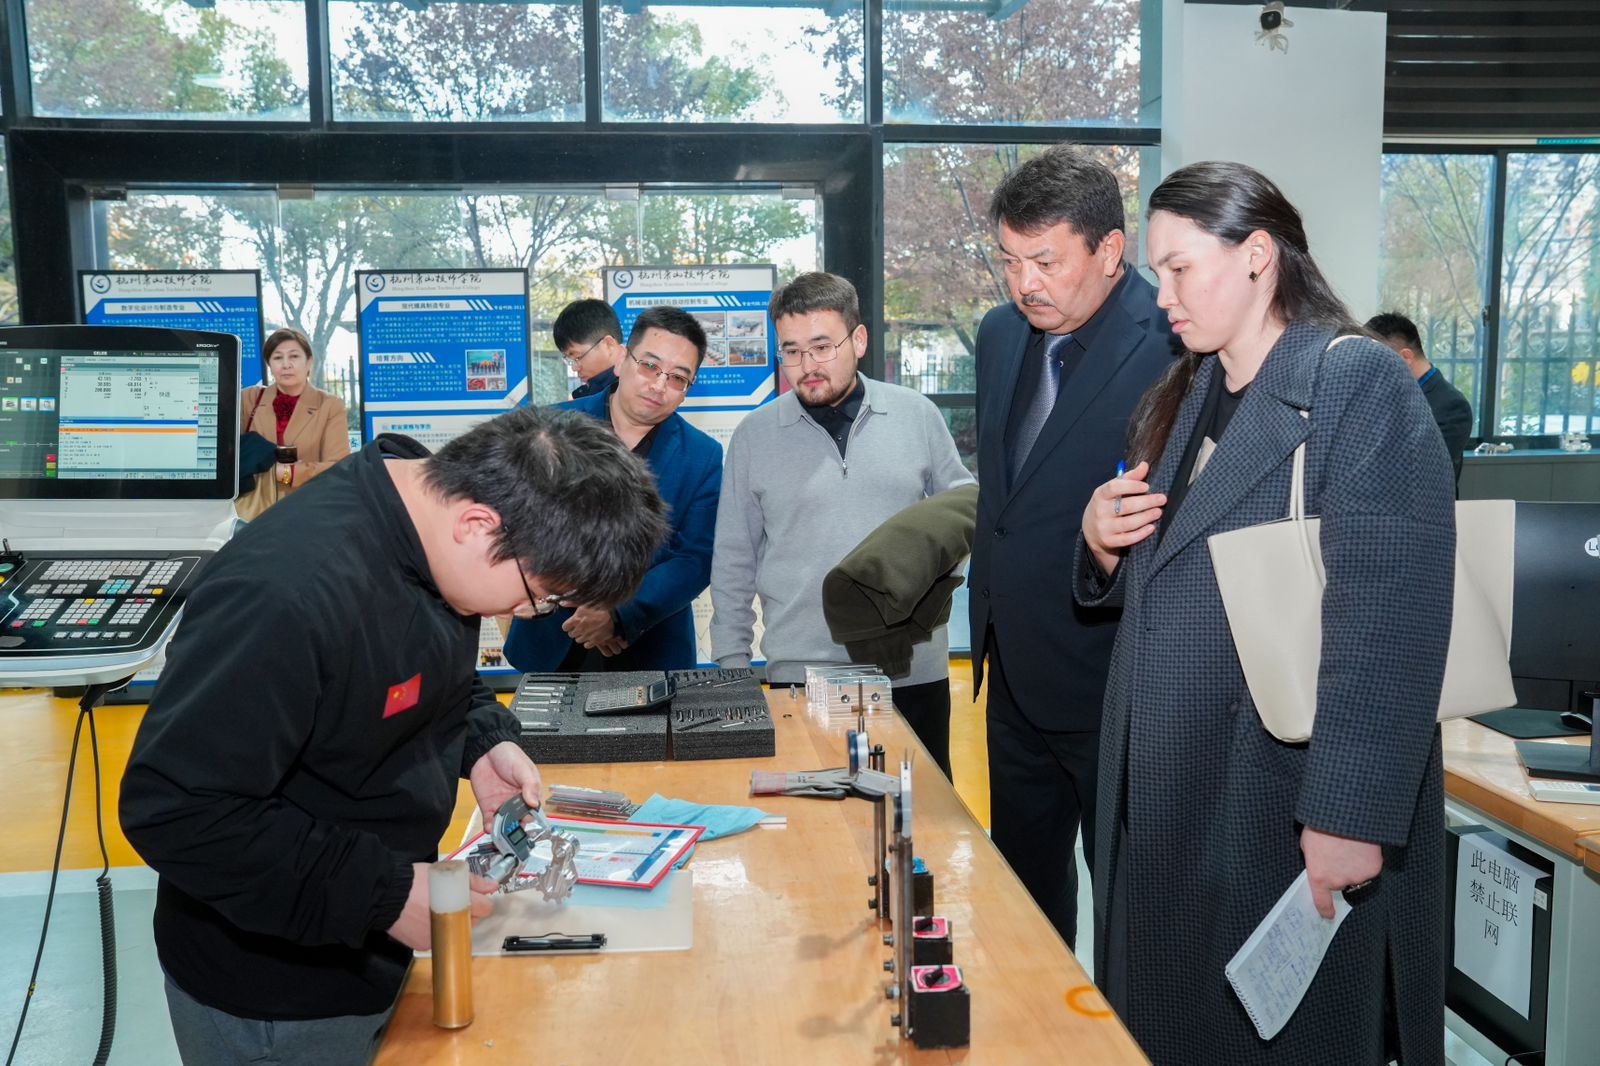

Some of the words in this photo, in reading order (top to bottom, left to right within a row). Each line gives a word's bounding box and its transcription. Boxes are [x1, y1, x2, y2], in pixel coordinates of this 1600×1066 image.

[1471, 850, 1520, 894] 此电脑
[1470, 879, 1518, 926] 禁止联
[1484, 919, 1499, 946] 网
